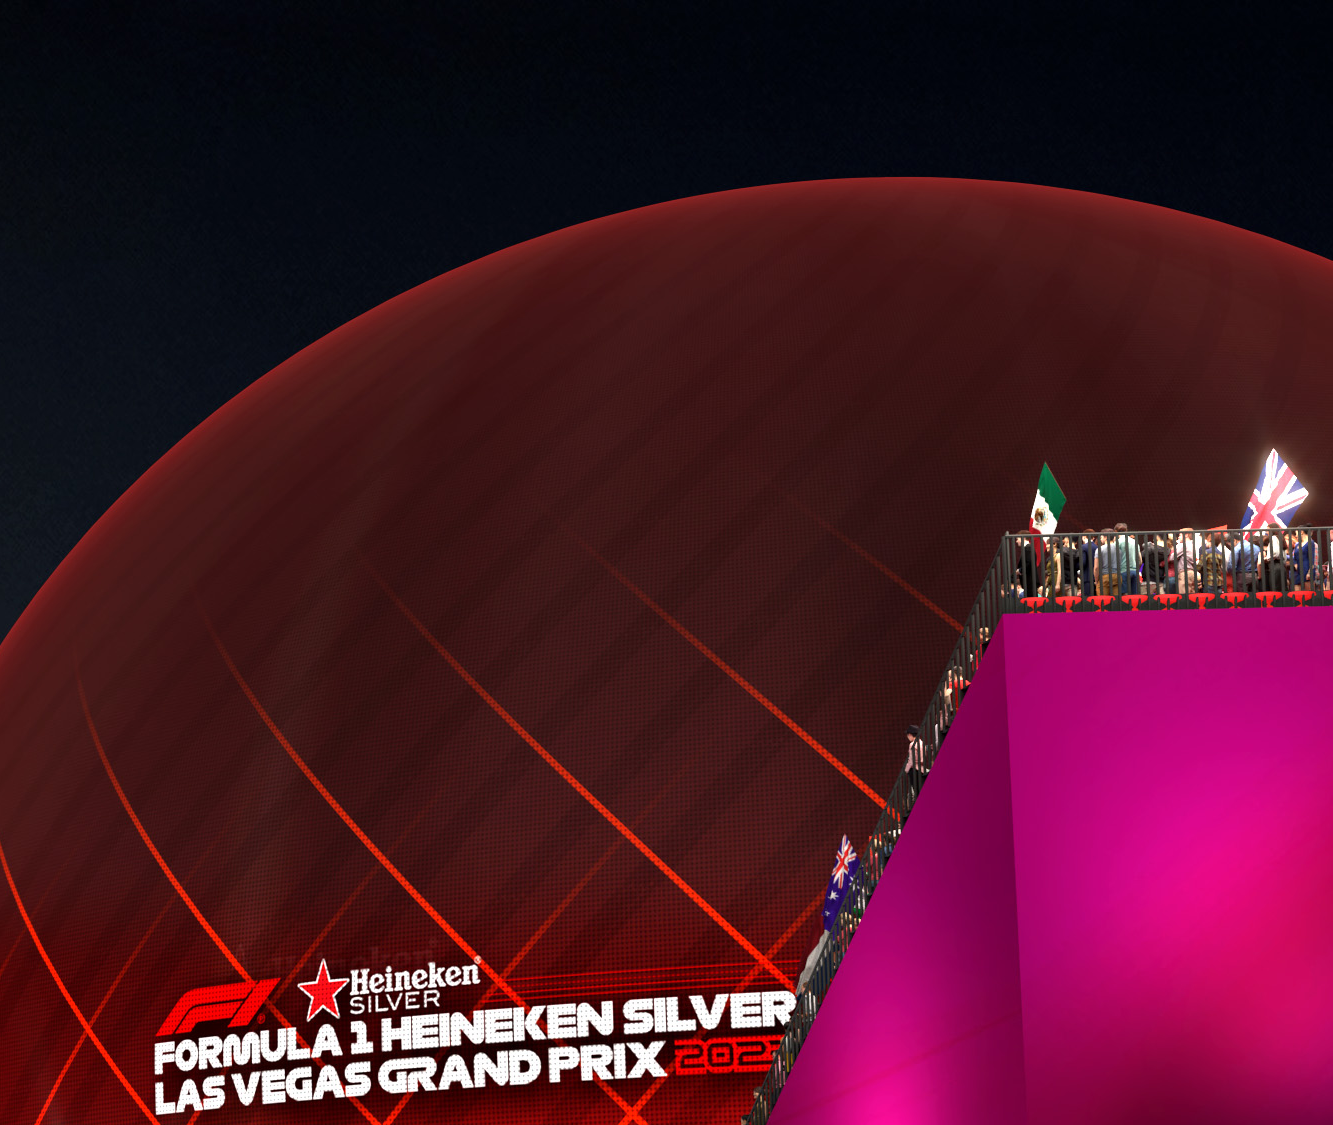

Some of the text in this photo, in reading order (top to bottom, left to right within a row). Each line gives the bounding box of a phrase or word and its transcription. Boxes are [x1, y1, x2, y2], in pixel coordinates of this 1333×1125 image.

[350, 962, 480, 996] Heineken
[350, 990, 440, 1015] SILVER
[155, 990, 797, 1075] FORMULA 1 HEINEKEN SILVER
[155, 1075, 226, 1115] LAS
[231, 1061, 372, 1105] VEGAS
[378, 1049, 541, 1093] GRAND
[548, 1041, 668, 1083] PRIX
